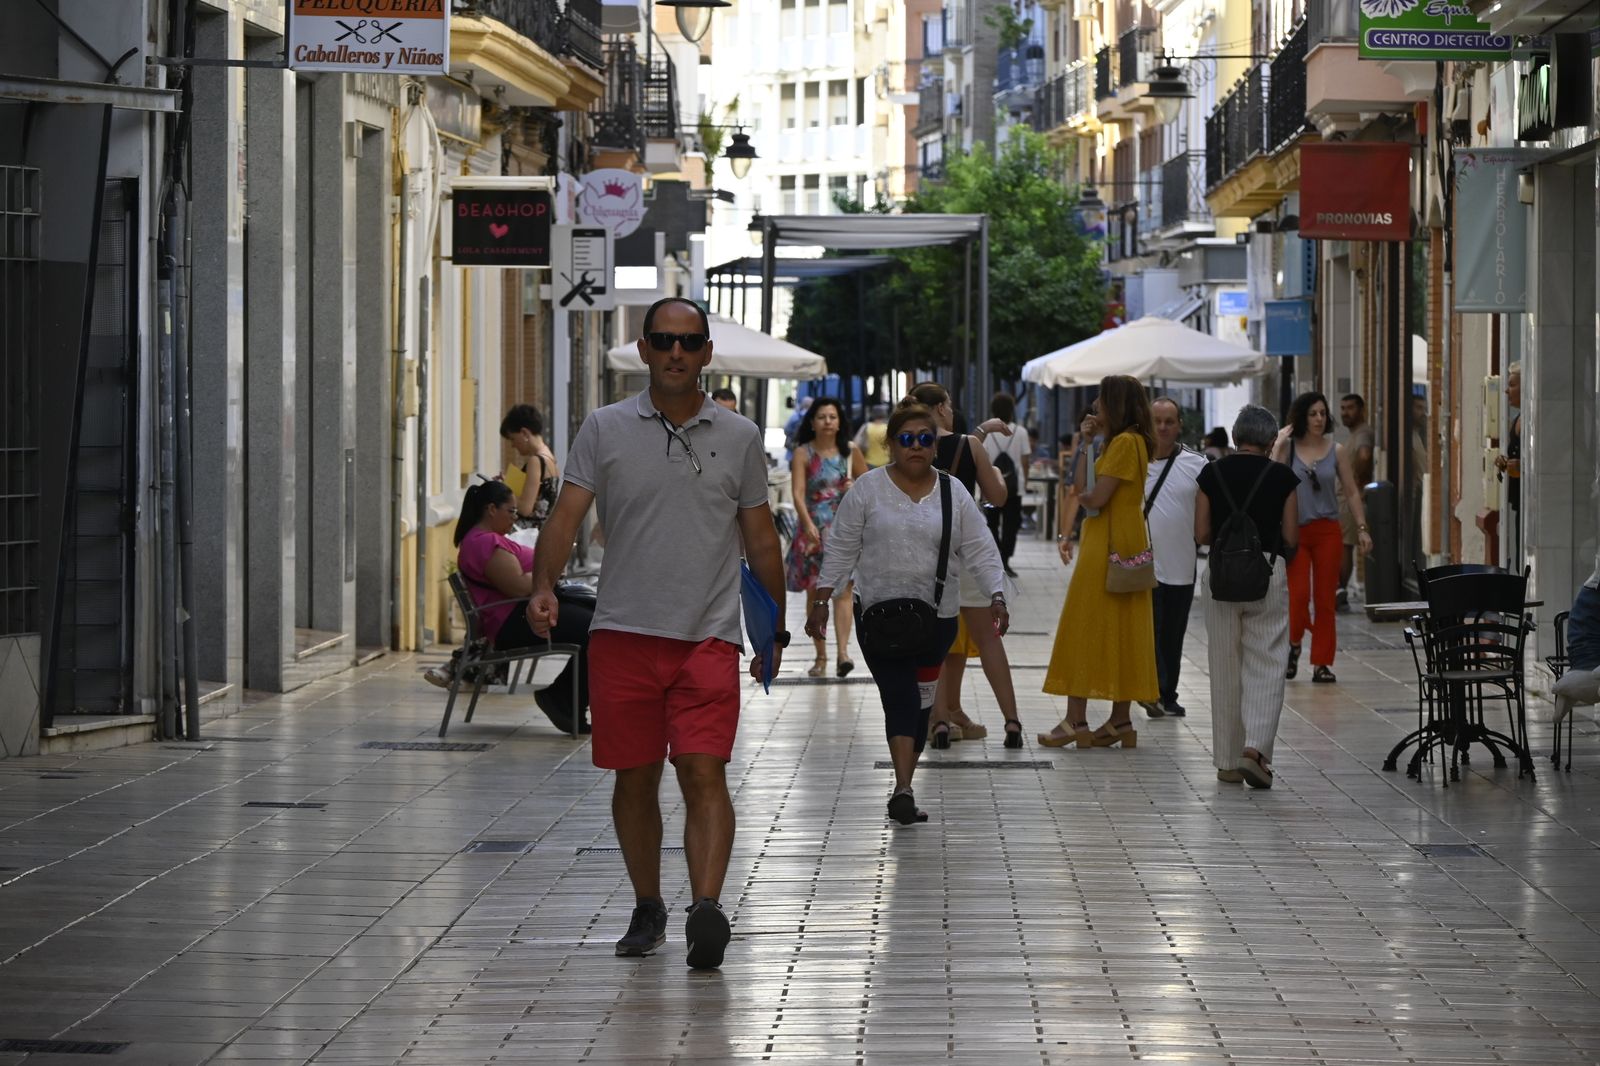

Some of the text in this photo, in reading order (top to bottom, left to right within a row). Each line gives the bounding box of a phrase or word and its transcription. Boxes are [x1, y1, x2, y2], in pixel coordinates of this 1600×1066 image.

[1373, 33, 1505, 48] CENTRO DIETETICO
[294, 45, 443, 69] Caballeros y Niños
[1316, 212, 1392, 225] PRONOVIAS
